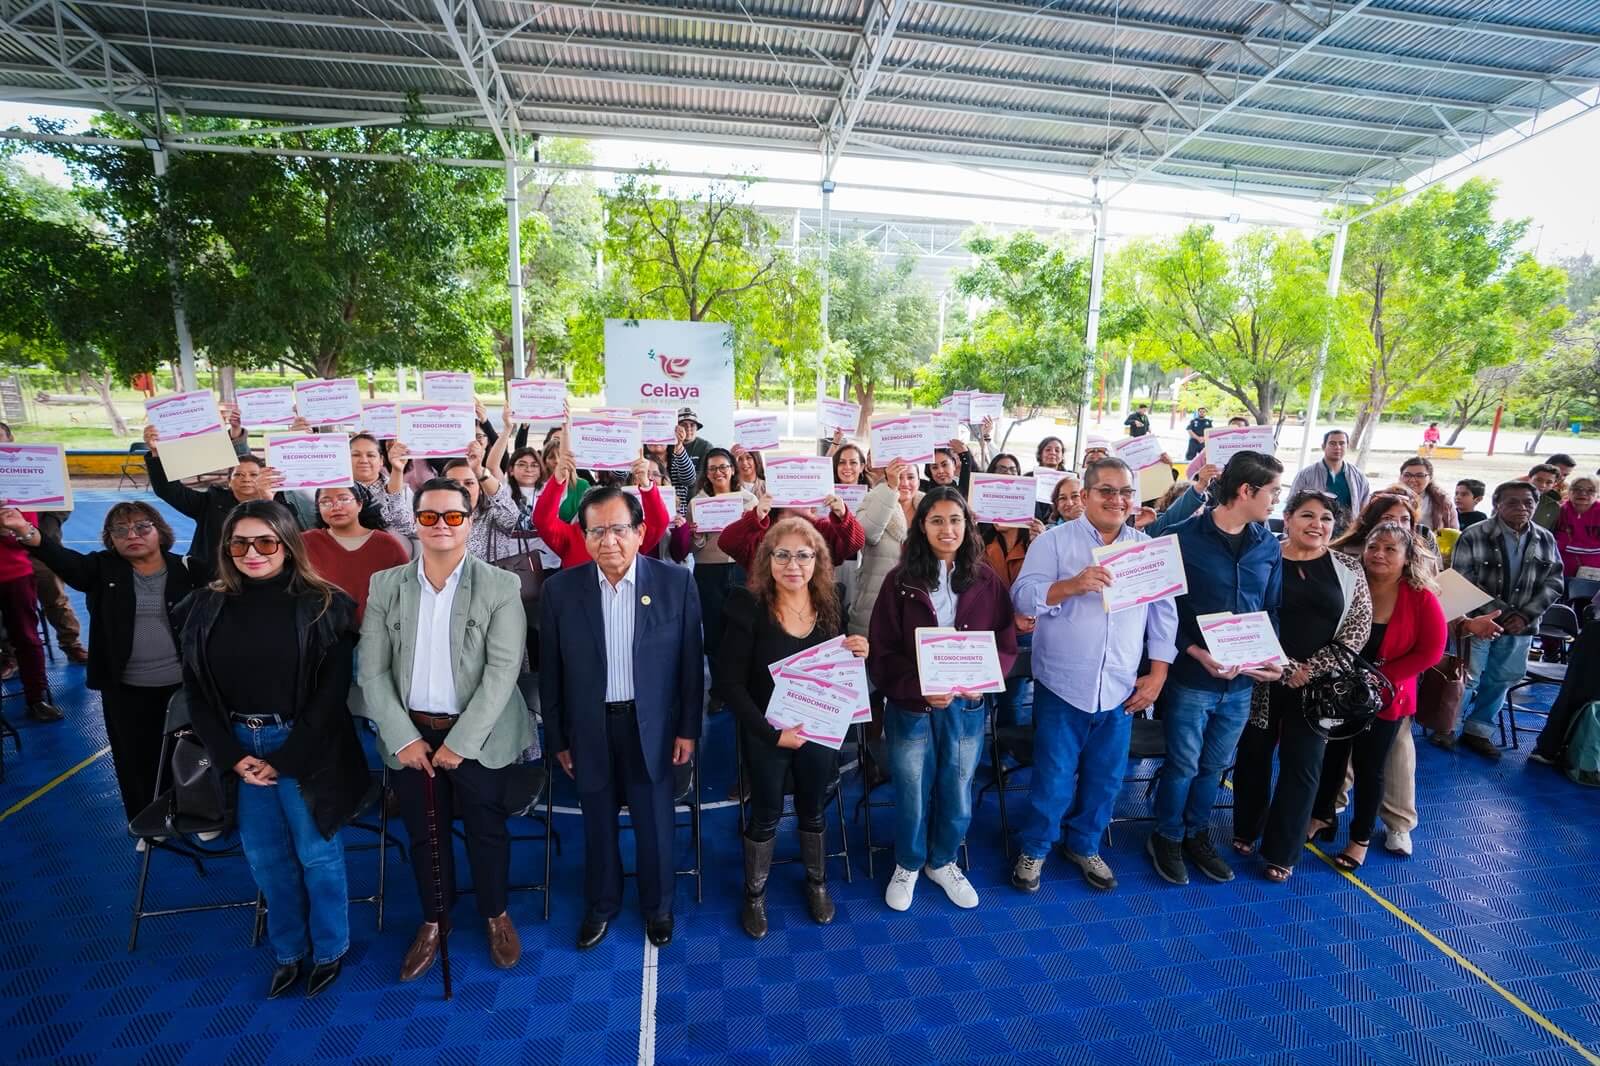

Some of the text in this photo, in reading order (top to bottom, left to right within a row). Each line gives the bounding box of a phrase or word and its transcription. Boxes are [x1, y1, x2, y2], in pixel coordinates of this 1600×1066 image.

[640, 383, 700, 400] Celaya
[159, 407, 205, 418] RECONOCIMIENTO
[1115, 560, 1165, 578] RECONOCIMIENTO
[786, 691, 840, 714] RECONOCIMIENTO
